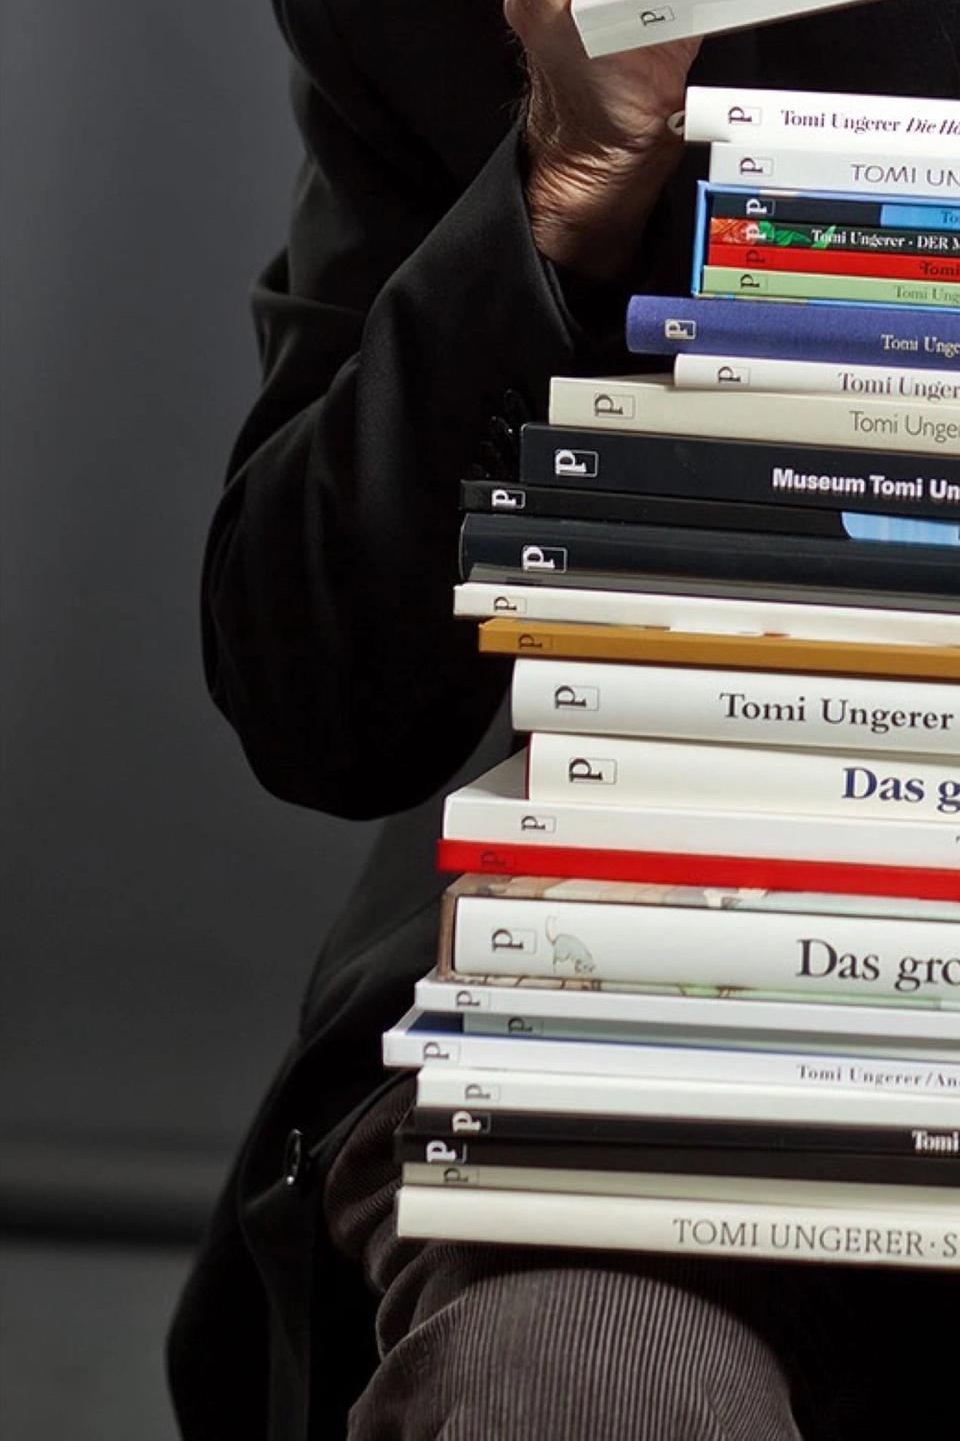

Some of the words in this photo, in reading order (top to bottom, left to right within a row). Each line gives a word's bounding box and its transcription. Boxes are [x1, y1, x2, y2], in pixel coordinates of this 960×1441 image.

[640, 11, 666, 26] P
[729, 106, 752, 124] P
[781, 110, 825, 128] Tomi
[832, 112, 901, 135] Ungerer
[906, 117, 937, 133] Die
[740, 158, 763, 175] P
[851, 163, 916, 184] TOMI
[746, 198, 767, 215] P
[811, 229, 847, 244] Tomi
[851, 231, 905, 248] Ungerer
[917, 235, 948, 251] DER
[919, 263, 960, 277] Tomi
[741, 274, 760, 289] P
[894, 285, 928, 300] Tomi
[665, 319, 688, 338] P
[881, 334, 919, 351] Tomi
[718, 366, 741, 383] P
[838, 372, 892, 394] Tomi
[594, 394, 624, 416] P
[849, 410, 899, 434] Tomi
[555, 450, 587, 475] P
[772, 467, 866, 494] Museum
[869, 474, 924, 498] Tomi
[491, 489, 518, 508] P
[522, 545, 555, 570] P
[494, 597, 518, 612] P
[518, 633, 543, 649] P
[555, 685, 588, 709] P
[720, 692, 806, 722] Tomi
[820, 698, 955, 734] Ungerer
[569, 758, 604, 782] P
[841, 766, 925, 802] Das
[521, 815, 546, 831] P
[491, 928, 524, 952] P
[796, 938, 880, 981] Das
[455, 990, 481, 1007] P
[424, 1042, 450, 1061] P
[797, 1064, 842, 1082] Tomi
[465, 1084, 491, 1100] P
[452, 1111, 482, 1132] P
[911, 1130, 959, 1152] Tomi
[426, 1140, 457, 1163] P
[443, 1167, 469, 1183] P
[672, 1218, 759, 1247] TOMI
[770, 1223, 925, 1257] UNGERER
